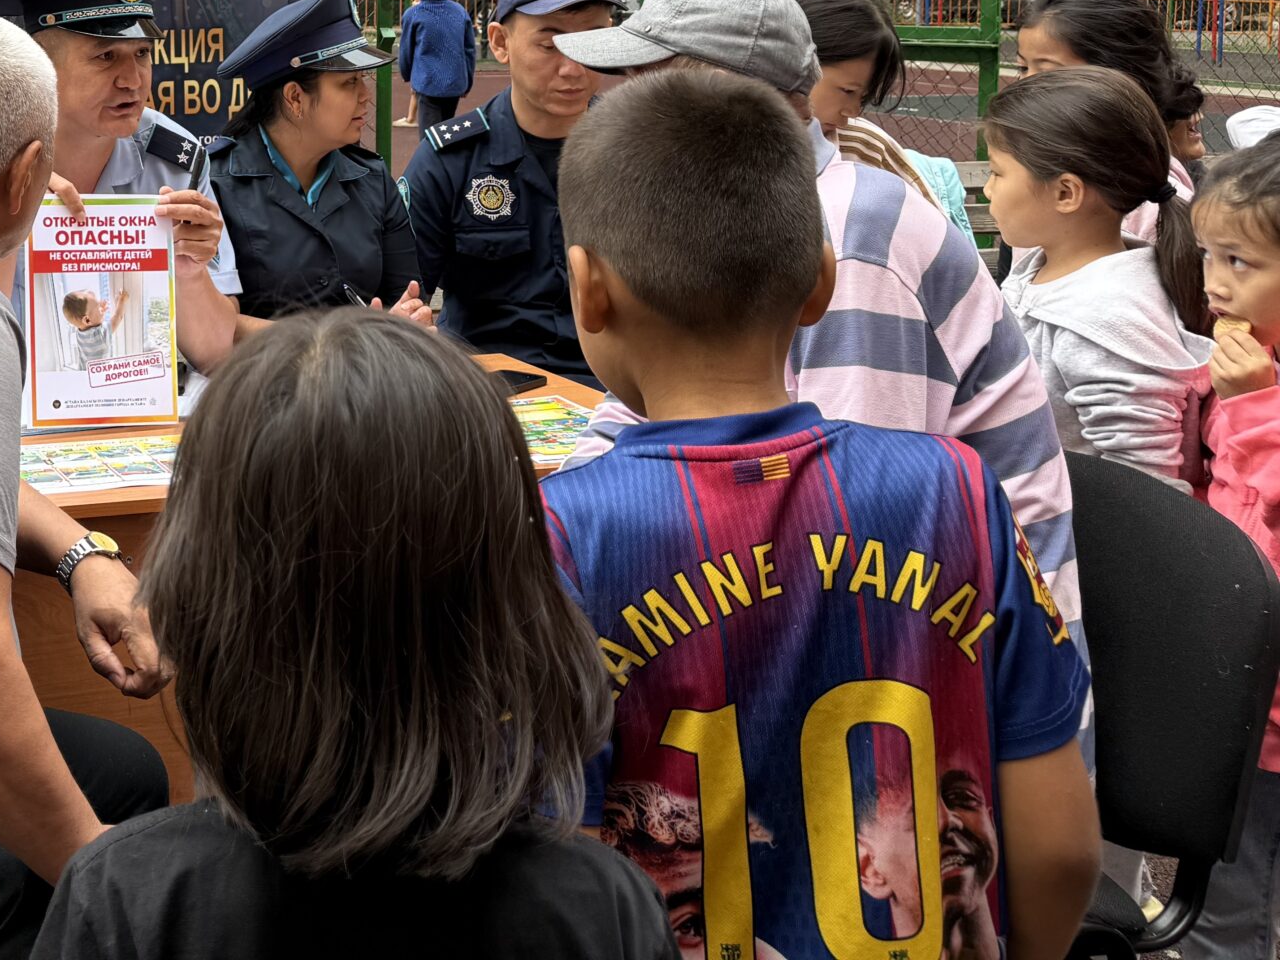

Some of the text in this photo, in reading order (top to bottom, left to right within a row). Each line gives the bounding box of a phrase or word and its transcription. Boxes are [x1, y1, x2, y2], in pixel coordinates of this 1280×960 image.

[149, 28, 224, 73] КЦИЯ
[183, 78, 221, 115] ВО
[118, 216, 157, 227] ОКНА
[55, 229, 146, 246] ОПАСНЫ!
[49, 250, 153, 260] НЕ ОСТАВЛЯЙТЕ ДЕТЕЙ
[61, 262, 140, 272] БЕЗ ПРИСМОТРА!
[90, 357, 160, 374] СОХРАНИ САМОЕ
[596, 532, 996, 701] AMINE YANAL
[659, 679, 943, 960] 10
